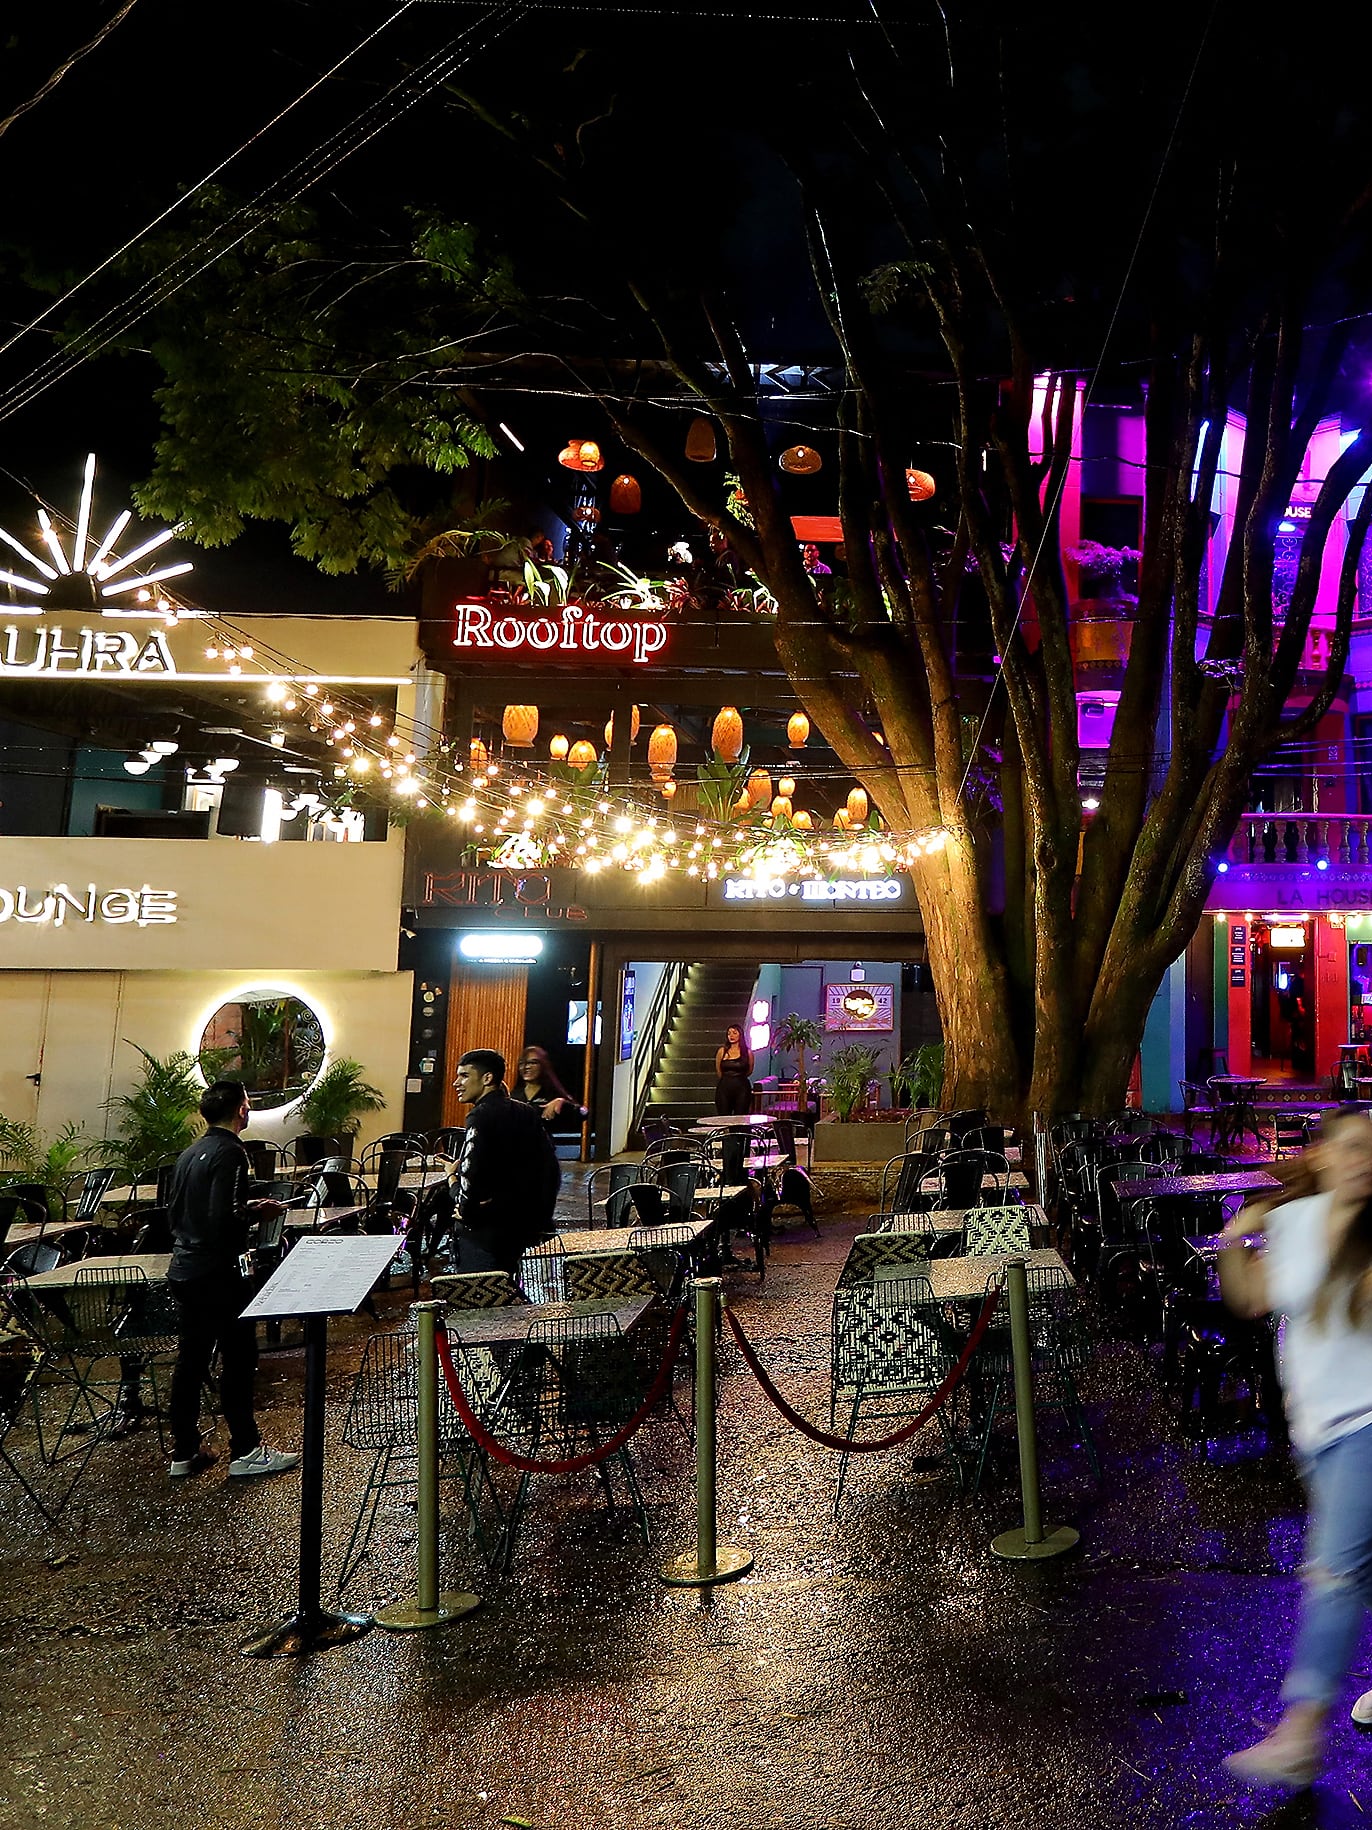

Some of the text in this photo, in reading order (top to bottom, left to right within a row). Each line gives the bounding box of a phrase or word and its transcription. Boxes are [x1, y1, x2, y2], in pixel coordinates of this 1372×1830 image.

[453, 604, 667, 663] Rooftop
[422, 871, 551, 905] RITO
[1277, 888, 1304, 905] LA
[494, 906, 588, 921] CLUB
